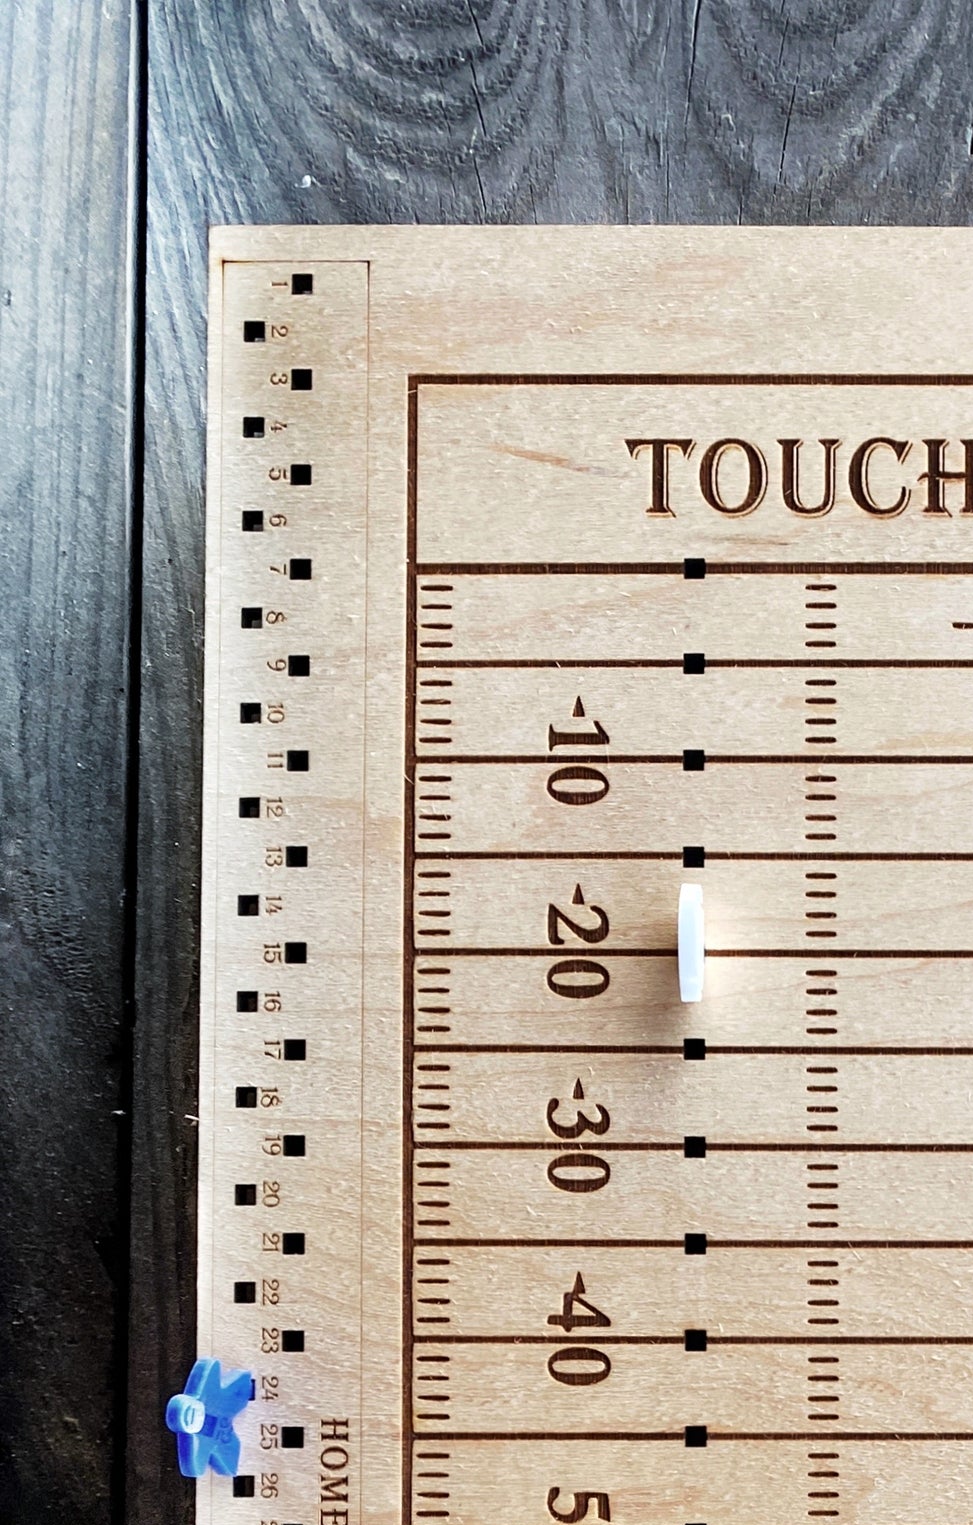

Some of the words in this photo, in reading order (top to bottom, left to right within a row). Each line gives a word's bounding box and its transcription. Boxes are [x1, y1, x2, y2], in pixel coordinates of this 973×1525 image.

[270, 324, 290, 339] 2
[269, 372, 289, 386] 3
[270, 420, 289, 434] 4
[268, 466, 288, 482] 5
[268, 513, 288, 528] 6
[269, 563, 288, 576] 7
[265, 609, 289, 625] 8
[266, 657, 286, 672] 9
[266, 702, 286, 724] 10
[266, 752, 285, 769] 11
[546, 719, 611, 807] 10
[265, 796, 286, 819] 12
[264, 845, 284, 868] 13
[265, 895, 284, 916] 14
[262, 942, 283, 964] 15
[546, 902, 611, 1000] 20
[263, 990, 283, 1013] 16
[263, 1039, 282, 1061] 17
[260, 1086, 283, 1109] 18
[261, 1133, 281, 1157] 19
[546, 1097, 612, 1194] 30
[261, 1180, 281, 1208] 20
[261, 1232, 281, 1253] 21
[261, 1278, 281, 1308] 22
[260, 1327, 280, 1354] 23
[546, 1290, 613, 1387] 40
[260, 1375, 280, 1403] 24
[259, 1423, 280, 1451] 25
[260, 1472, 280, 1499] 26
